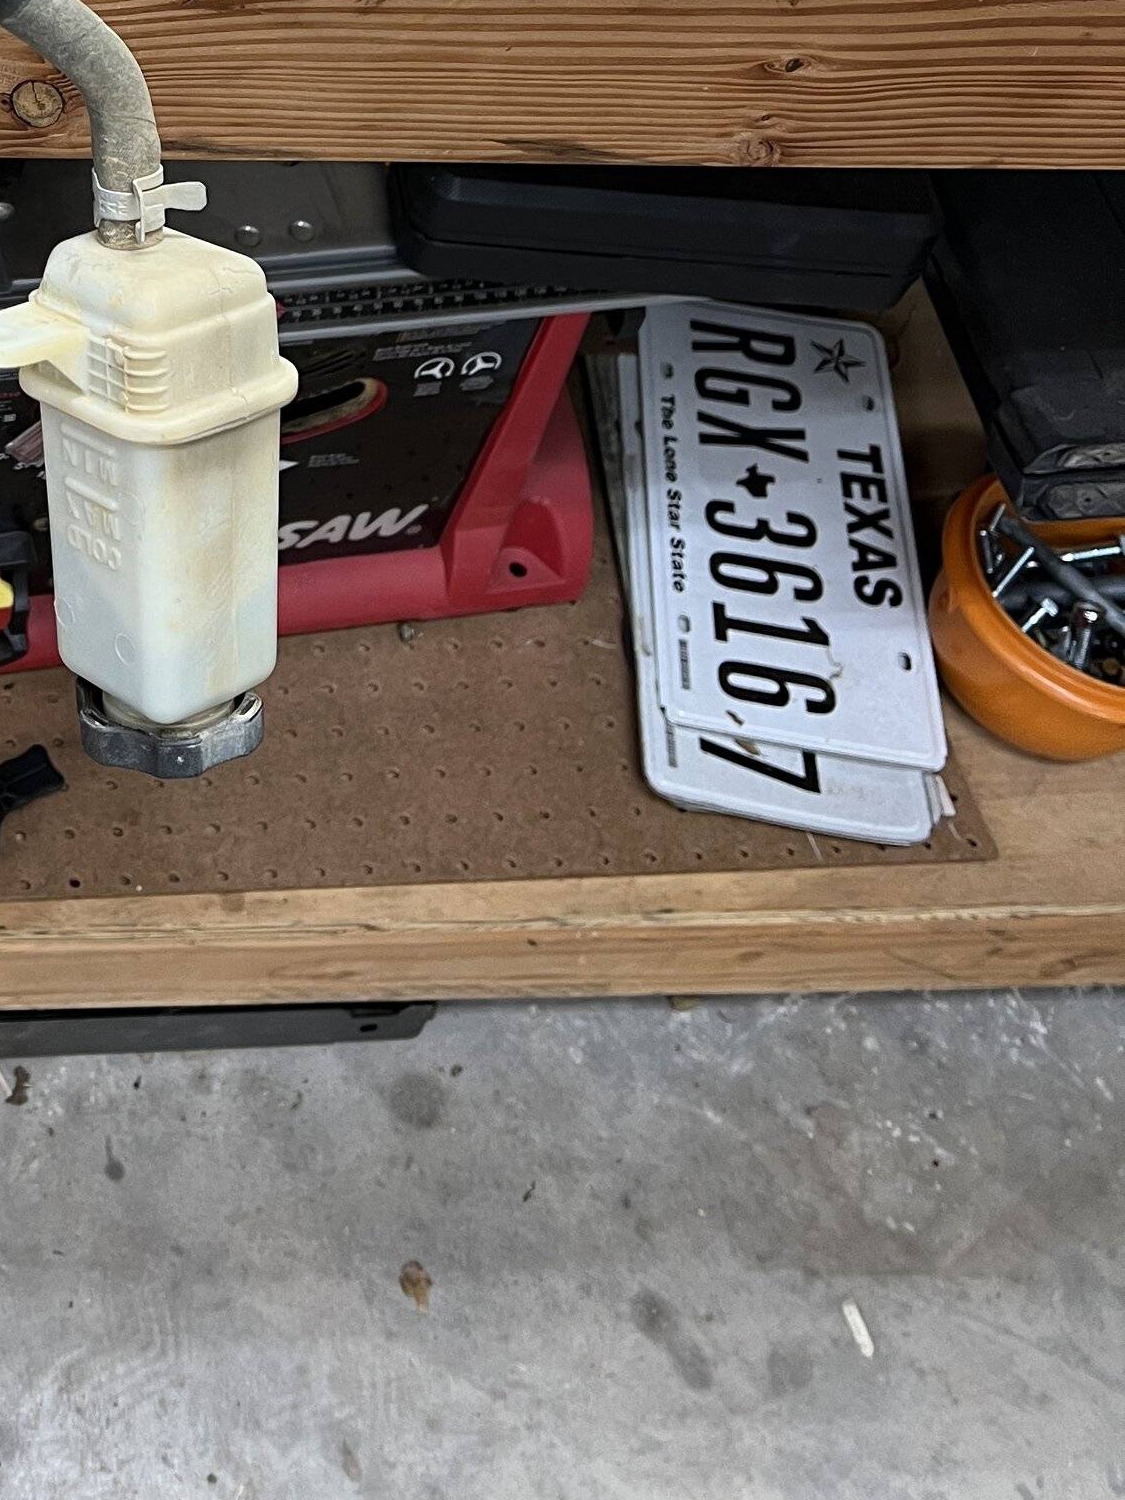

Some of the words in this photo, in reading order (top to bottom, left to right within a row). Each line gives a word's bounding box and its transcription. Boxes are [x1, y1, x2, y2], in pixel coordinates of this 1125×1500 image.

[661, 396, 676, 430] The
[690, 319, 809, 463] RGX
[663, 436, 678, 483] Lone
[667, 488, 682, 532] Star
[836, 444, 903, 610] TEXAS
[670, 537, 687, 593] State
[704, 500, 837, 714] 3616
